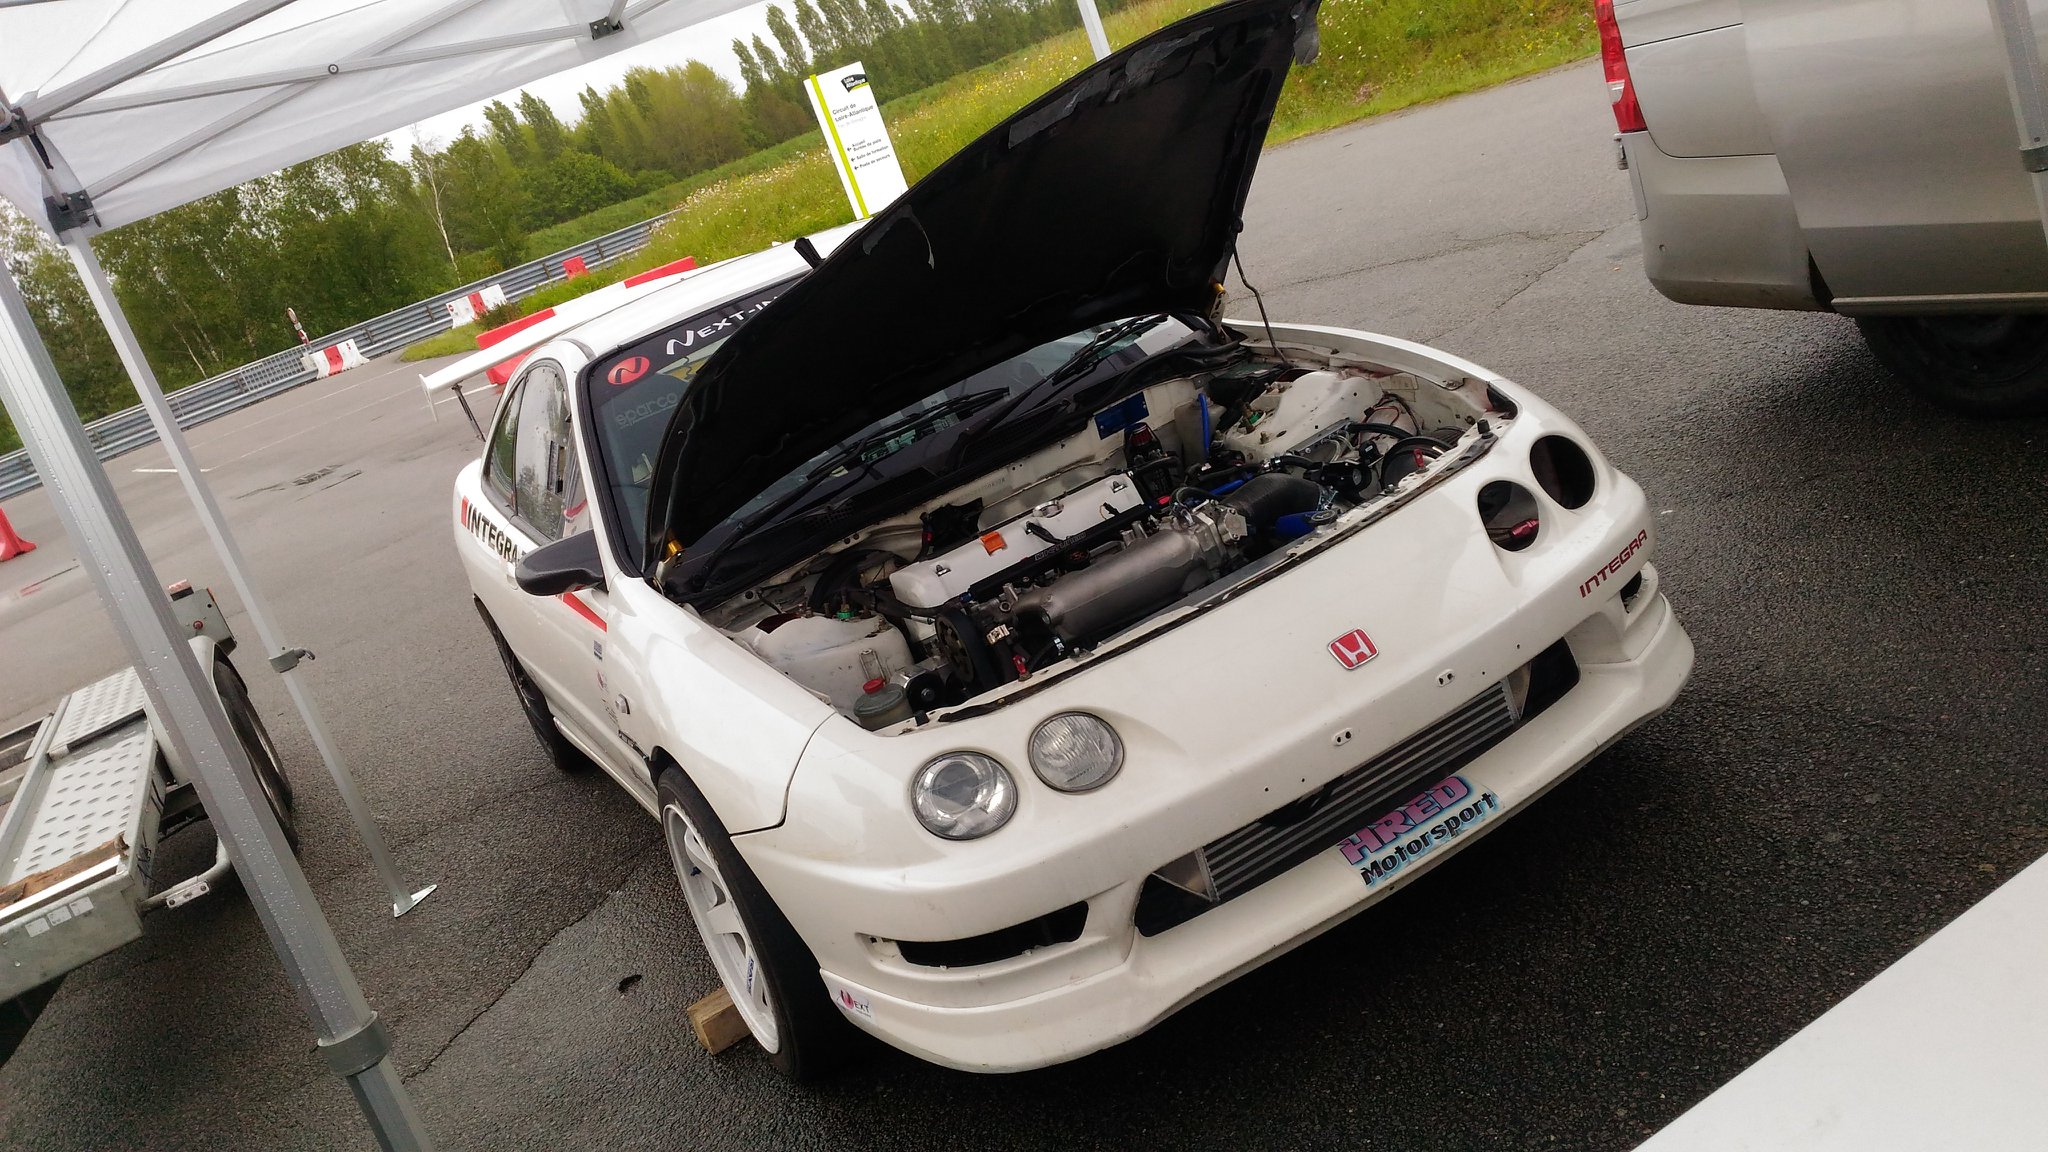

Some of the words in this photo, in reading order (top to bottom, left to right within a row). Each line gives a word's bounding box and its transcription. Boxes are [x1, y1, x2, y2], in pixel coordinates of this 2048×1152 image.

[832, 105, 849, 114] Circuit
[835, 105, 873, 121] Loire-Atlantique
[615, 391, 679, 427] sparco
[1578, 528, 1648, 598] INTEGRA
[1336, 775, 1470, 866] HRED
[1360, 791, 1495, 886] Motorsport
